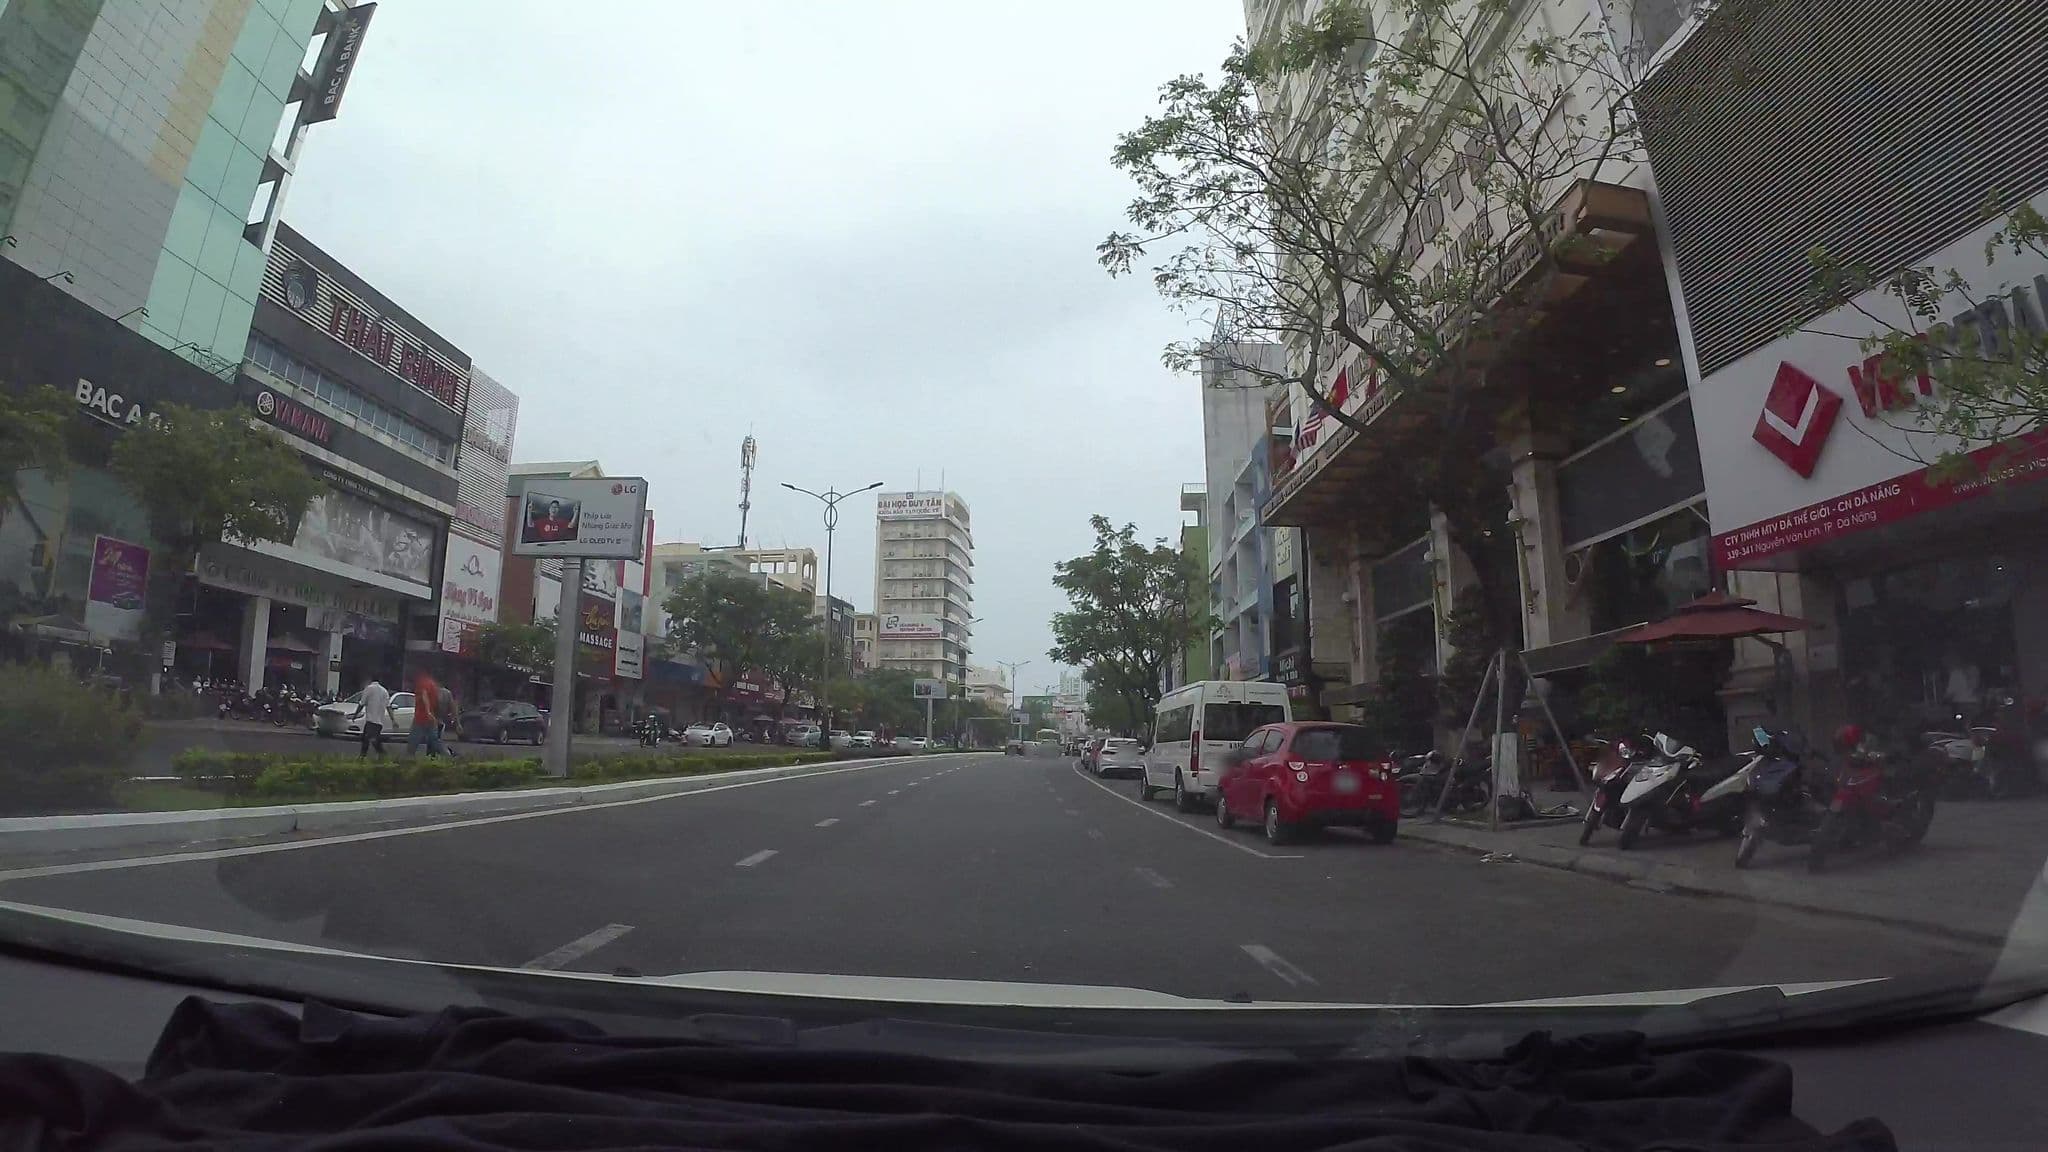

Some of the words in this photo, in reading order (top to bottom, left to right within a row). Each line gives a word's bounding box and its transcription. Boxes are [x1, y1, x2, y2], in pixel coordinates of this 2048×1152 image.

[340, 25, 361, 61] BANK
[335, 63, 347, 73] A
[323, 77, 342, 105] BAC
[75, 378, 124, 418] BAC
[624, 485, 637, 494] LG
[1724, 533, 1739, 546] CTY
[1740, 527, 1761, 543] TNHH
[1761, 522, 1779, 537] MTV
[1793, 510, 1809, 528] THẾ
[1809, 503, 1831, 521] GIỚI
[1837, 498, 1852, 513] CN
[1854, 494, 1869, 508] ĐÀ
[579, 631, 613, 649] MASSAGE
